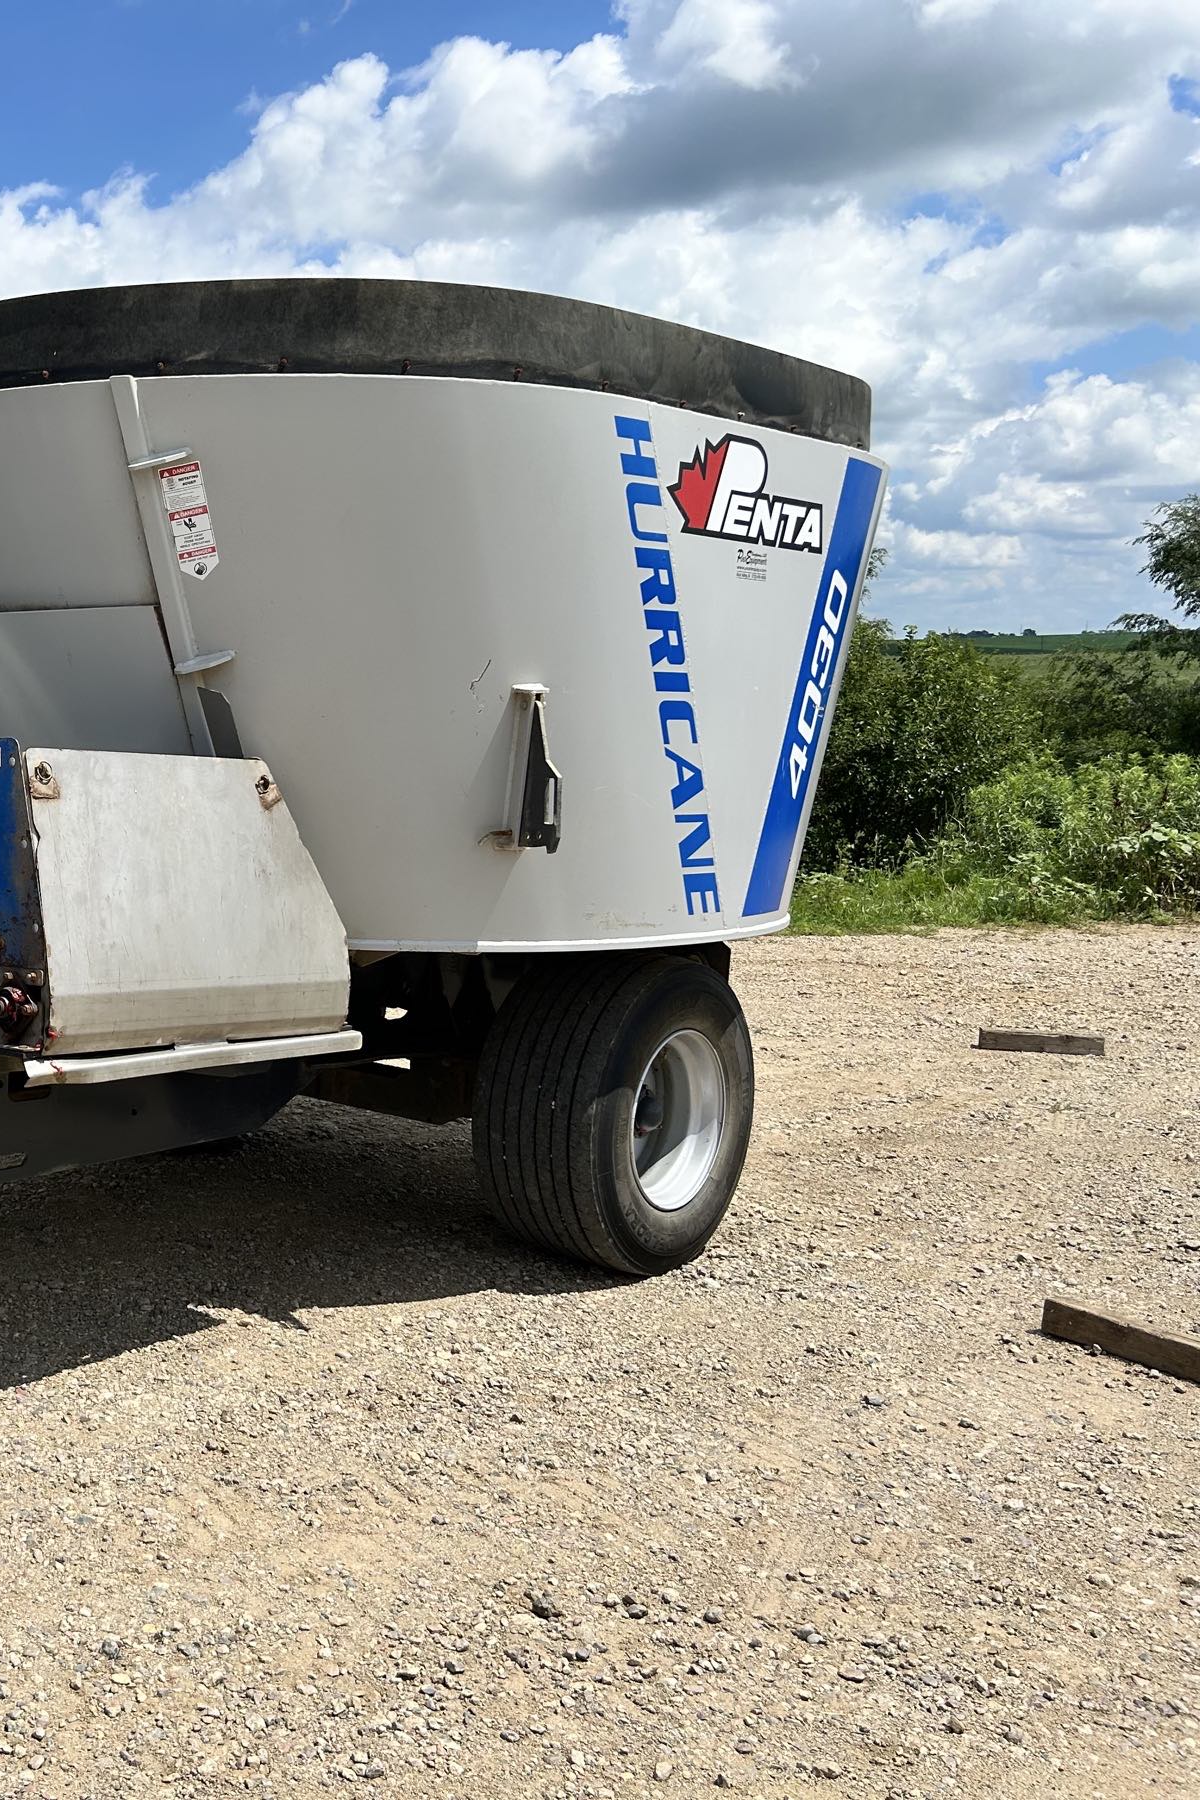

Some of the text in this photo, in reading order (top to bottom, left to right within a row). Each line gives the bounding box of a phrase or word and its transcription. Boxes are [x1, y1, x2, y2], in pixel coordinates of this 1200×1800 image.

[172, 465, 196, 475] DANGER
[704, 437, 822, 549] PENTA
[180, 508, 203, 518] DANGER
[191, 547, 212, 557] DANGER
[614, 415, 721, 915] HURRICANE
[788, 569, 848, 799] 4030
